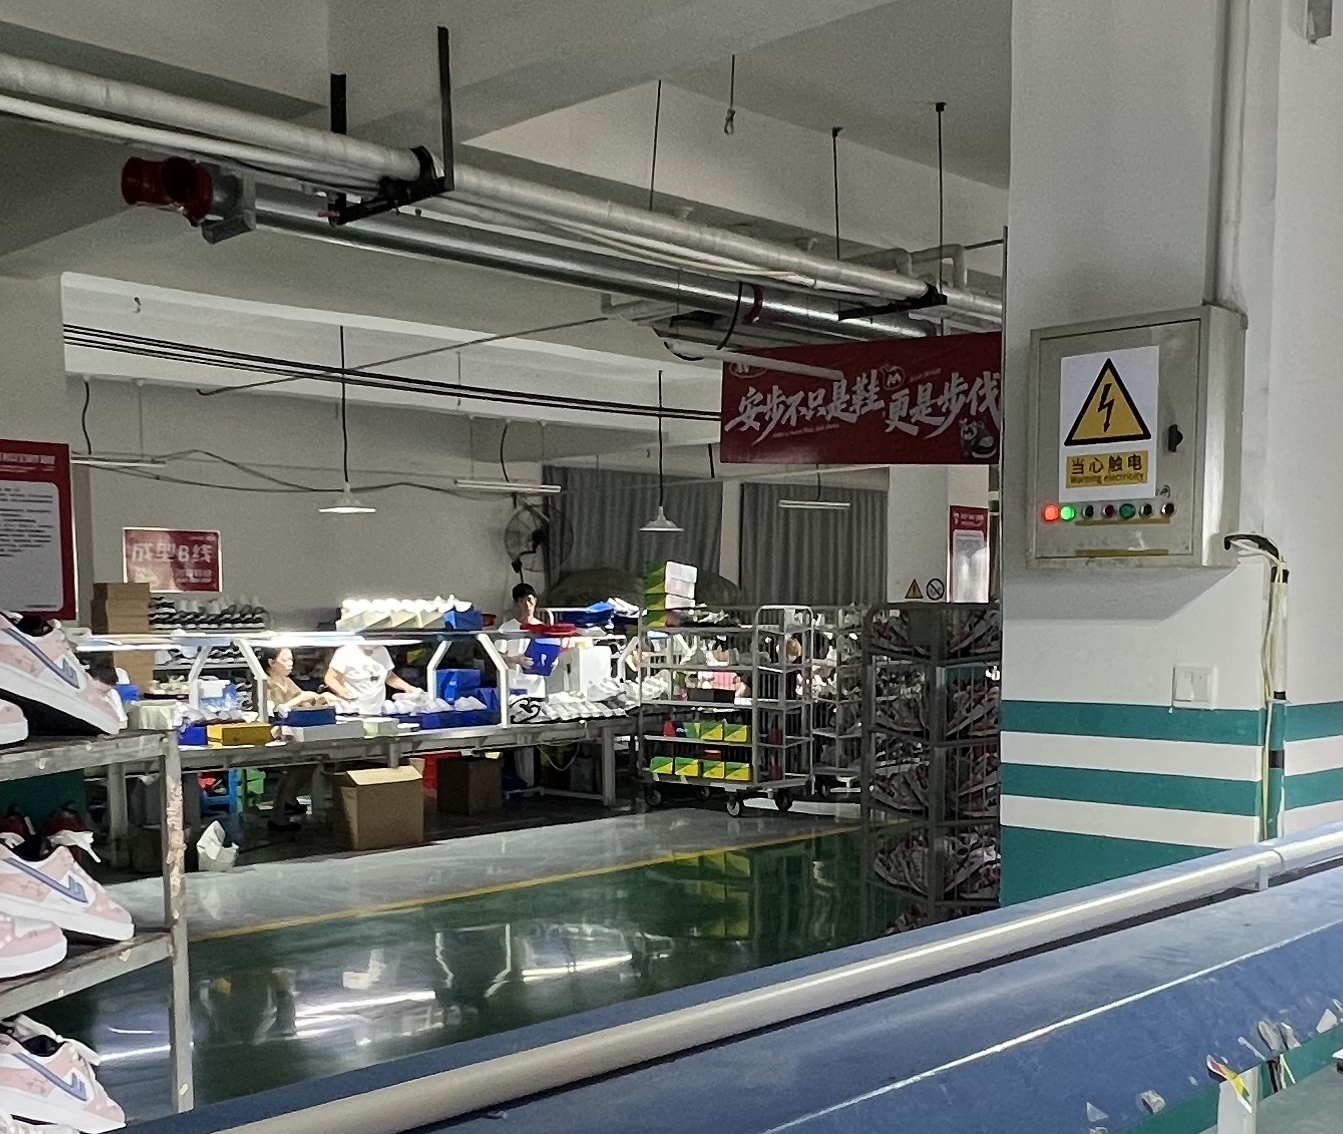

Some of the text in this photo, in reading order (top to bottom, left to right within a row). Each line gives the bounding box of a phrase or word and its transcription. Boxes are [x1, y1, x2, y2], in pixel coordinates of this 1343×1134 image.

[1071, 453, 1143, 475] 当心触电
[131, 542, 213, 563] 成型B线
